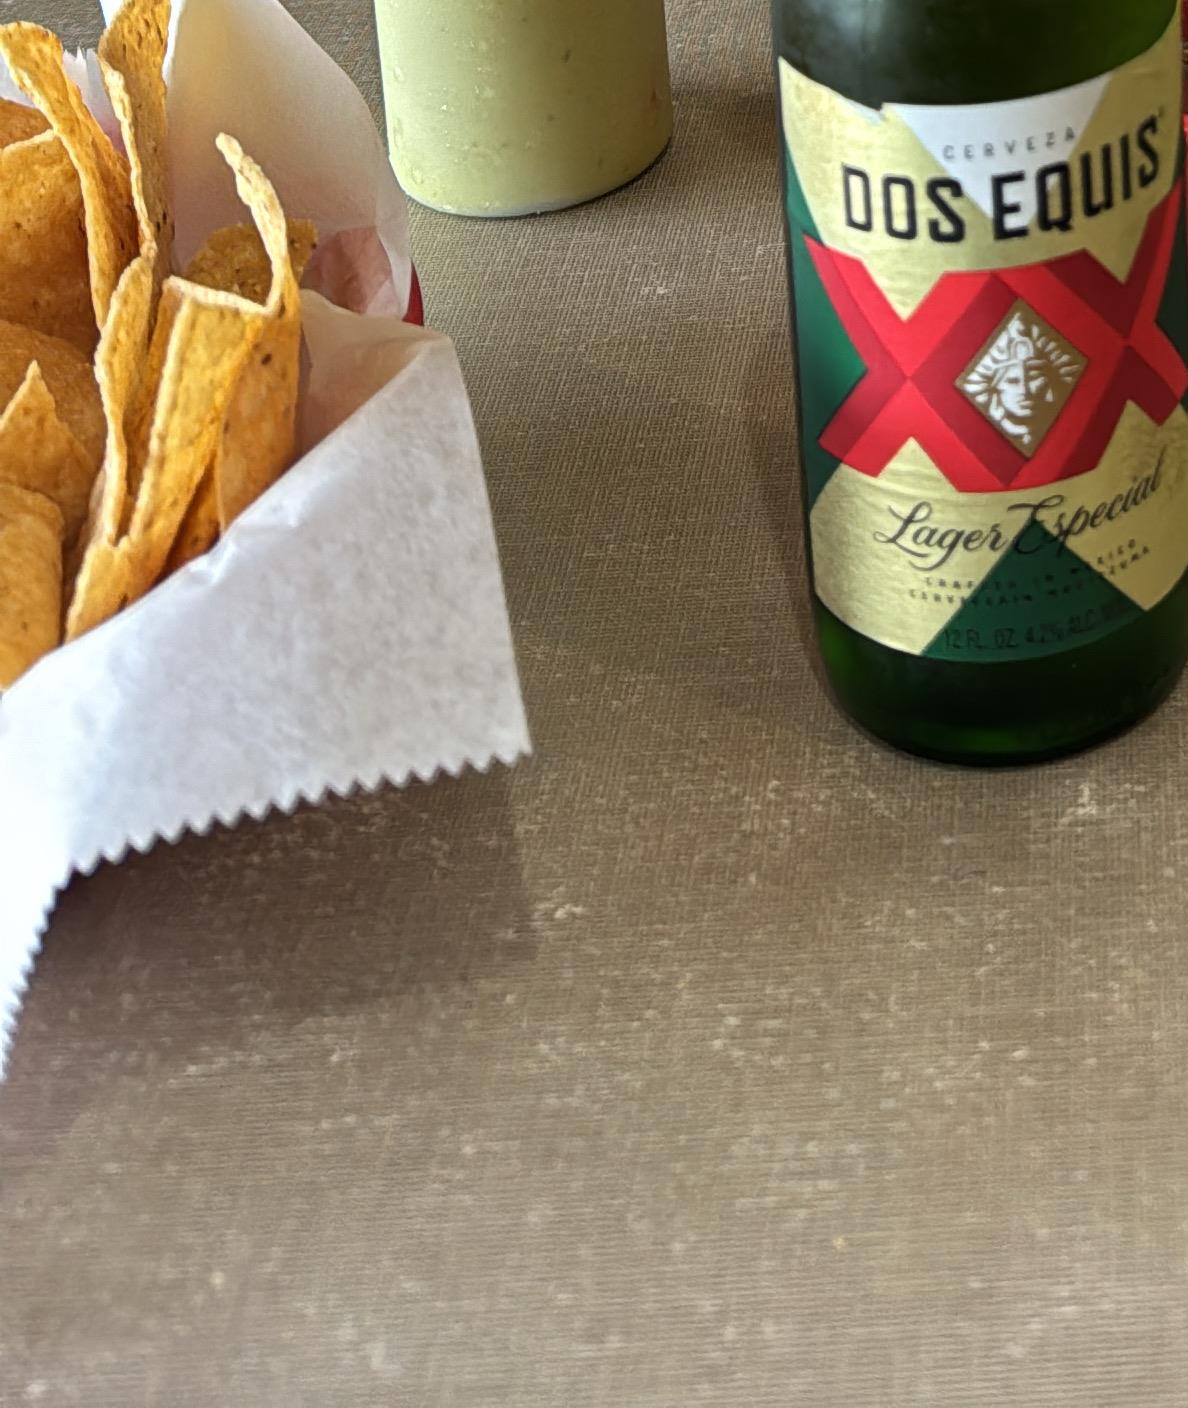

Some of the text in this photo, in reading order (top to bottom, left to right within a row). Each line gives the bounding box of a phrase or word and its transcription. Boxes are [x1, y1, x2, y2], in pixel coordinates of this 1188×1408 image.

[841, 117, 1162, 244] DOS EQUIS
[942, 125, 1079, 162] CERVEZA
[873, 446, 1169, 572] Lager Especial
